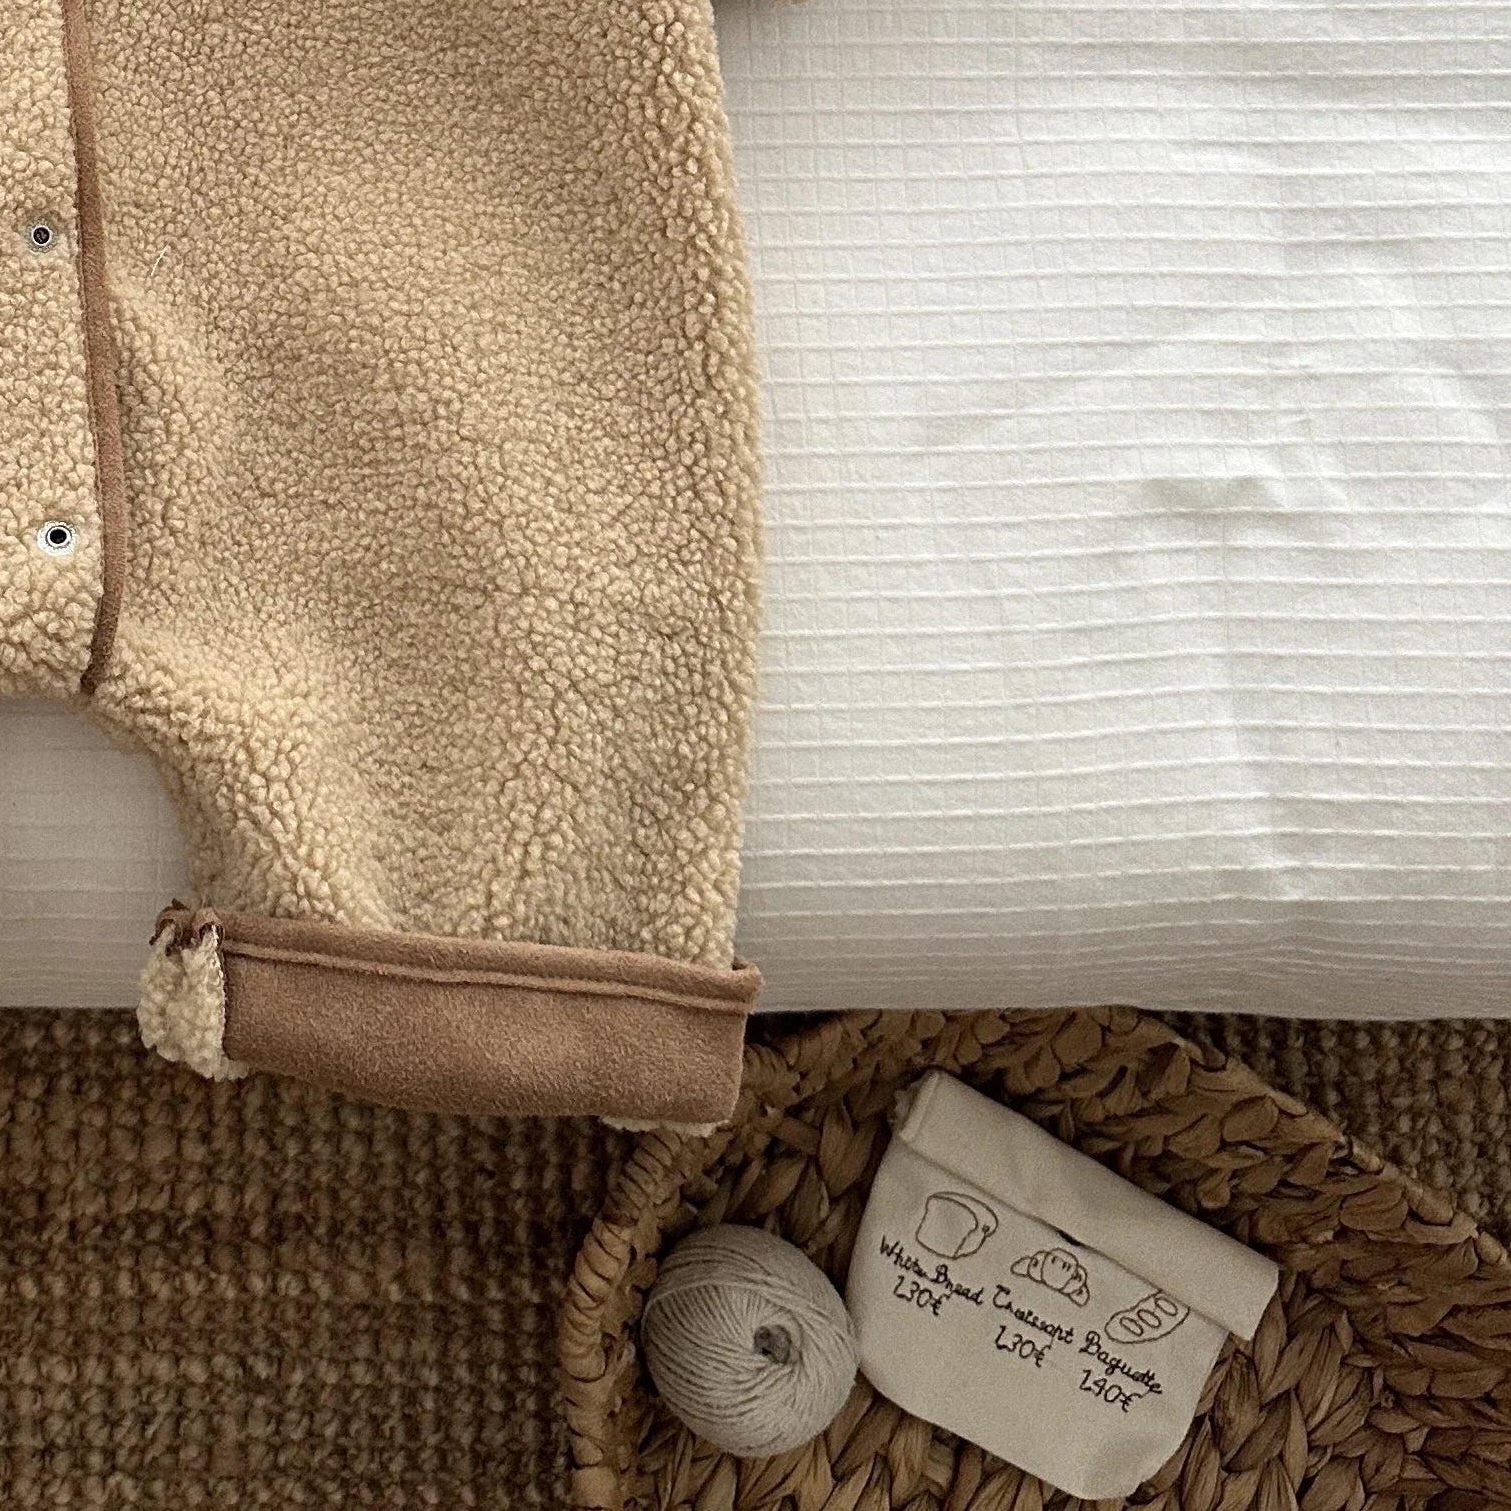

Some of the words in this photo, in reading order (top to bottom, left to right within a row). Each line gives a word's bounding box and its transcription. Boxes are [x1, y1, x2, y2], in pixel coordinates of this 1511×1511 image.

[930, 1264, 984, 1306] Bread
[993, 1284, 1074, 1345] Croissant
[1079, 1330, 1163, 1394] Baguette
